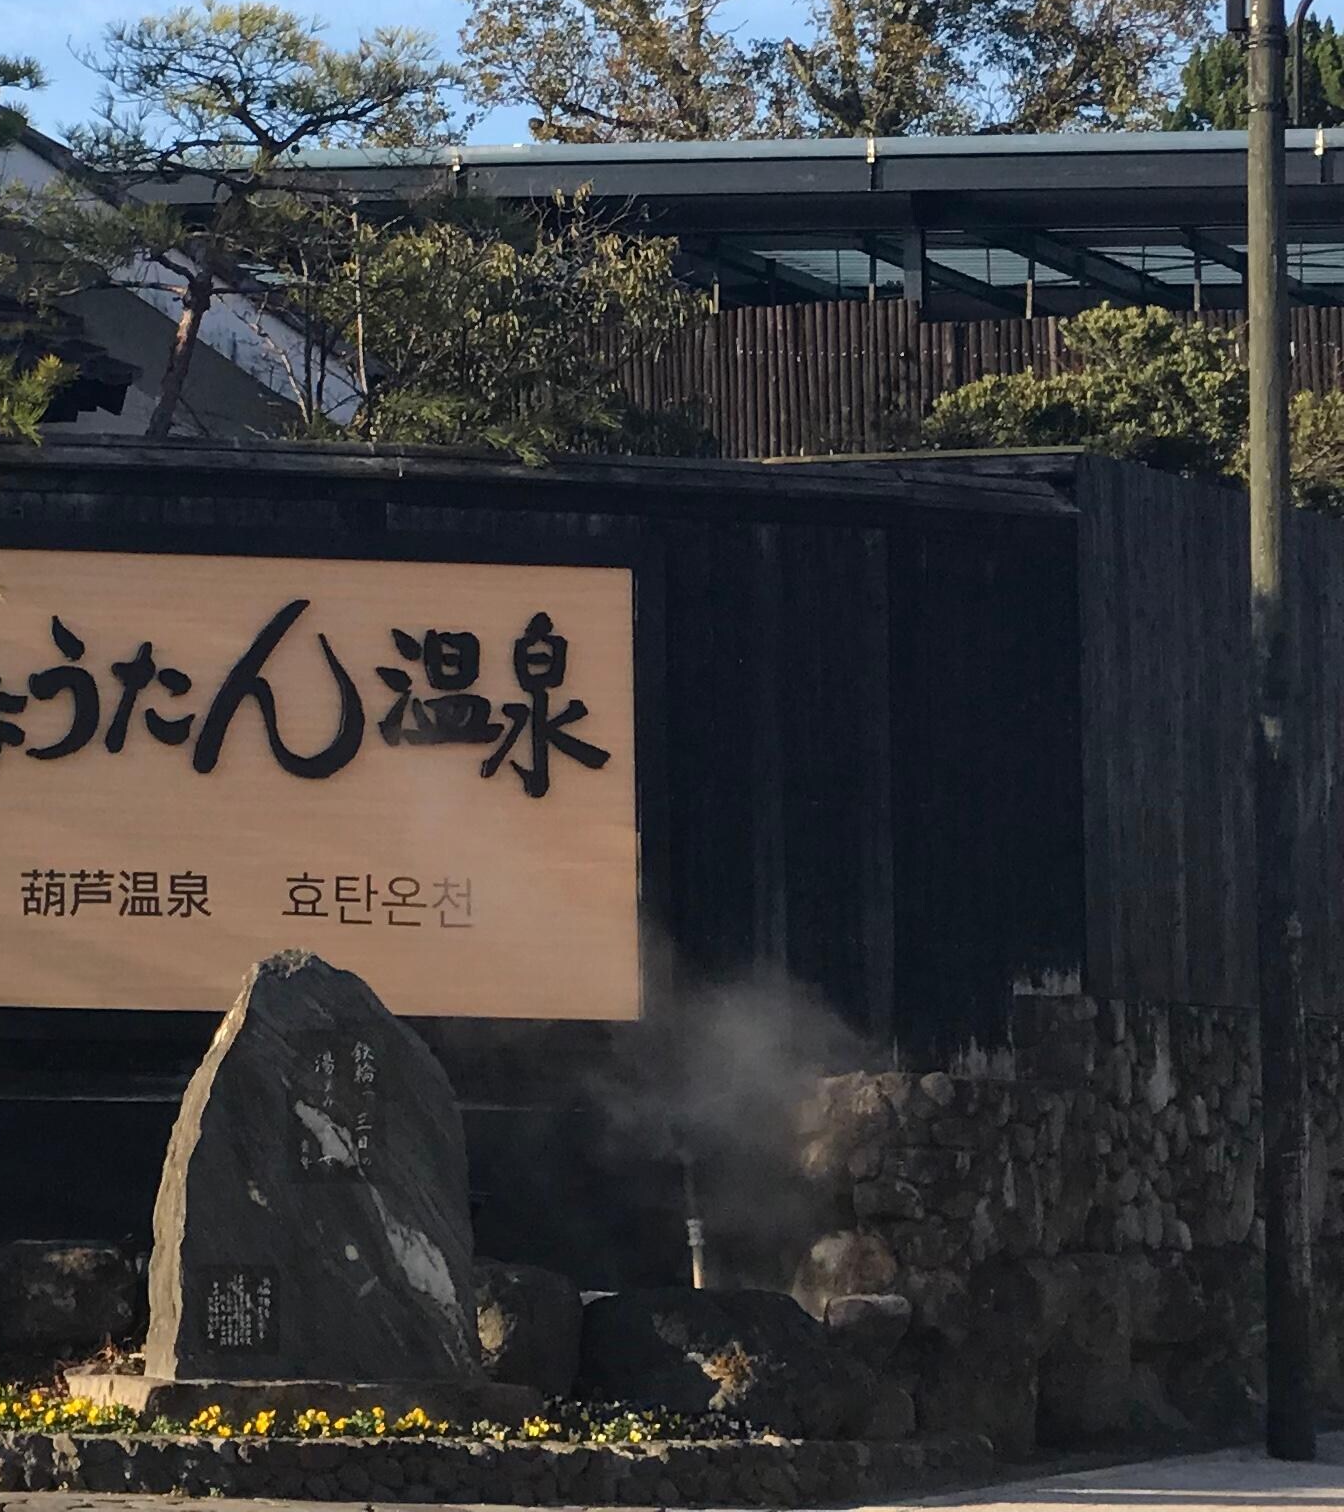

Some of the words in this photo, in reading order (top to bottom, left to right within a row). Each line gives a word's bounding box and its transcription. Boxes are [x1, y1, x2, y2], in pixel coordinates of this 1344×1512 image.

[20, 869, 212, 918] 葫芦温泉
[281, 871, 474, 928] 효탄온천
